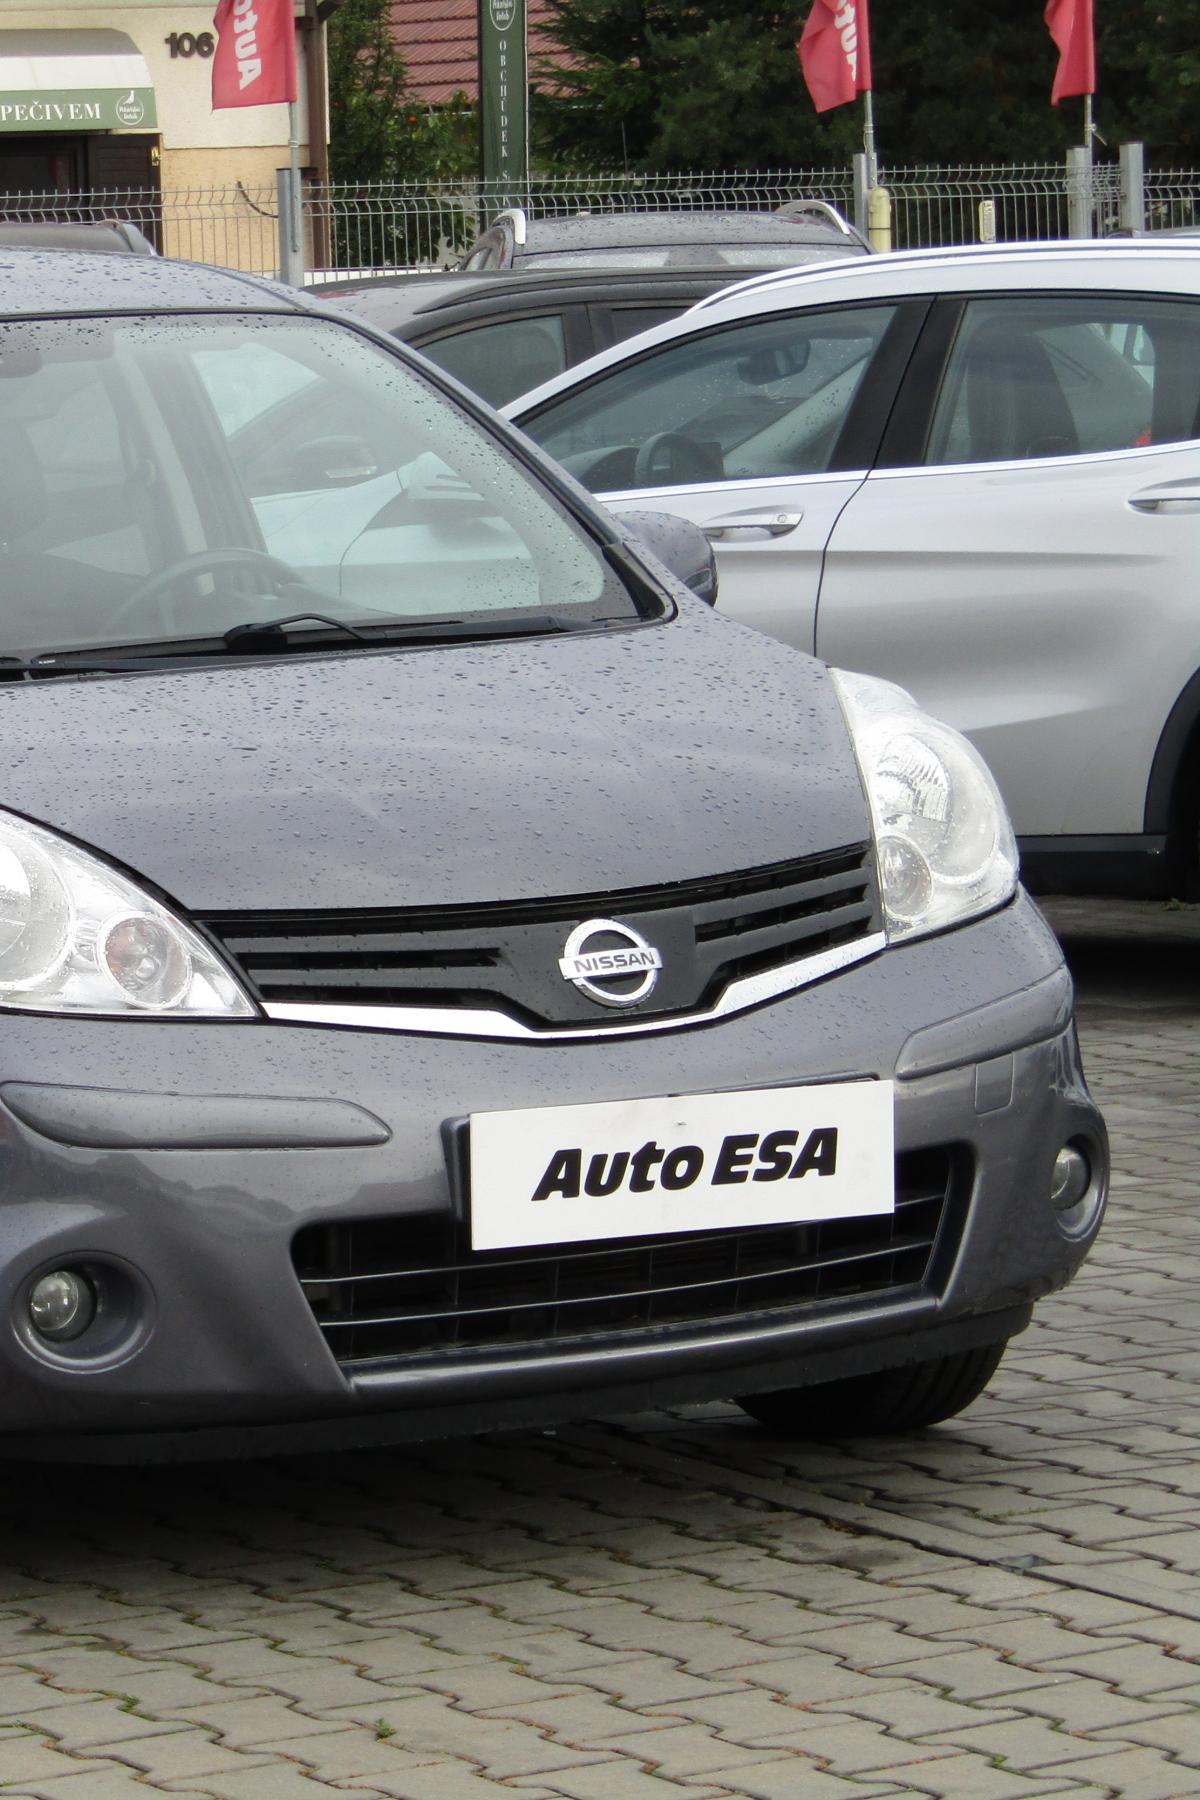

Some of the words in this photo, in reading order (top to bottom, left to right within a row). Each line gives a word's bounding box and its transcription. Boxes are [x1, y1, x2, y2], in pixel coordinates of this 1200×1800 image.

[164, 32, 215, 59] 106
[0, 100, 101, 122] PEČIVEM
[574, 951, 656, 974] NISSAN
[531, 1141, 704, 1202] Auto
[711, 1127, 839, 1186] ESA
